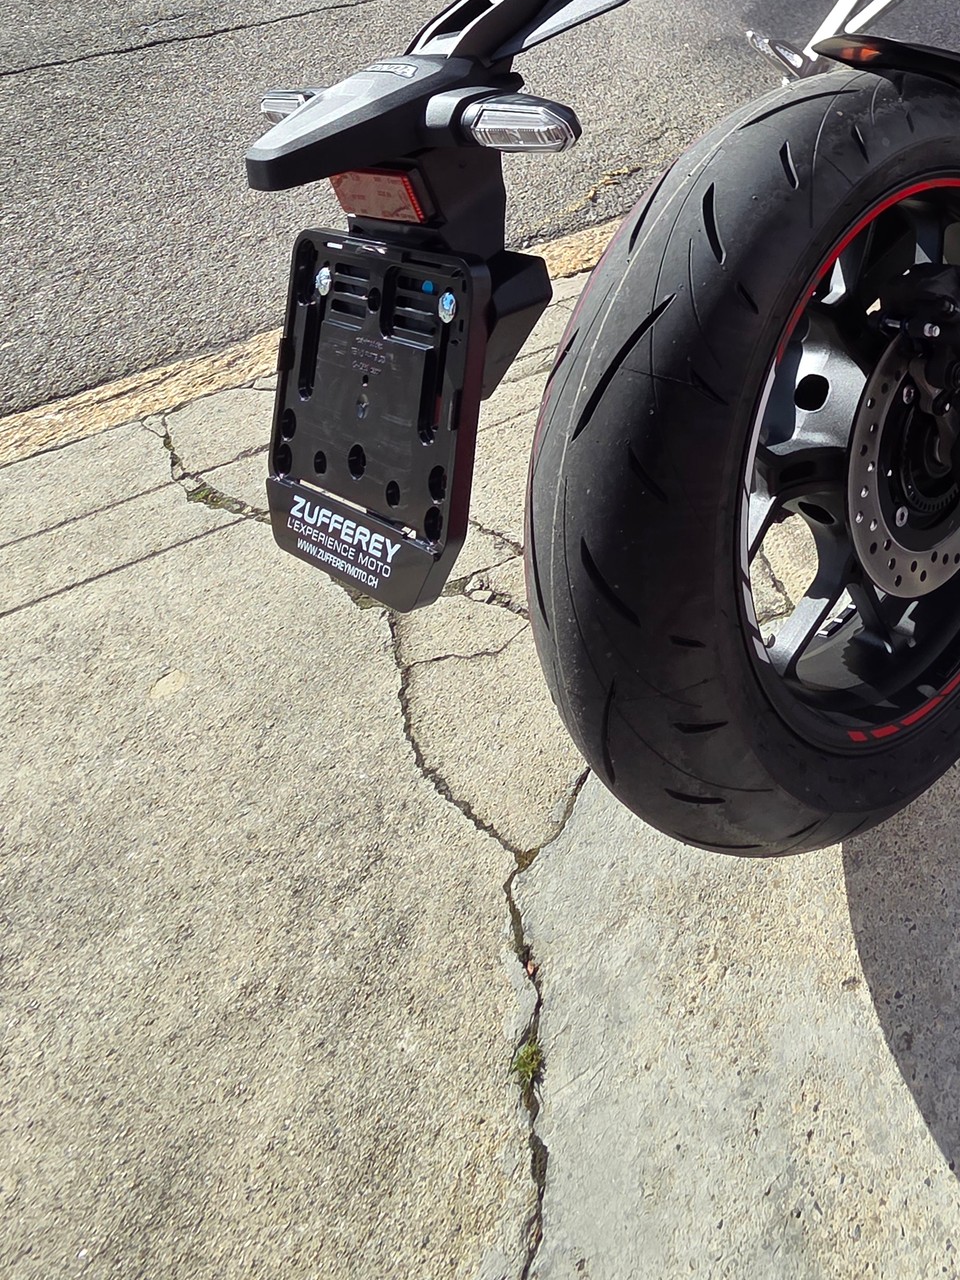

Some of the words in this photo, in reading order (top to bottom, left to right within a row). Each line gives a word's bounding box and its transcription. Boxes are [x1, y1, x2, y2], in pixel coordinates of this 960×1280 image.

[286, 516, 356, 560] L'EXPERIENCE
[358, 552, 391, 578] MOTO
[290, 494, 401, 563] ZUFFEREY
[297, 537, 379, 589] WWW.ZUFFEREYMOTO.CH
